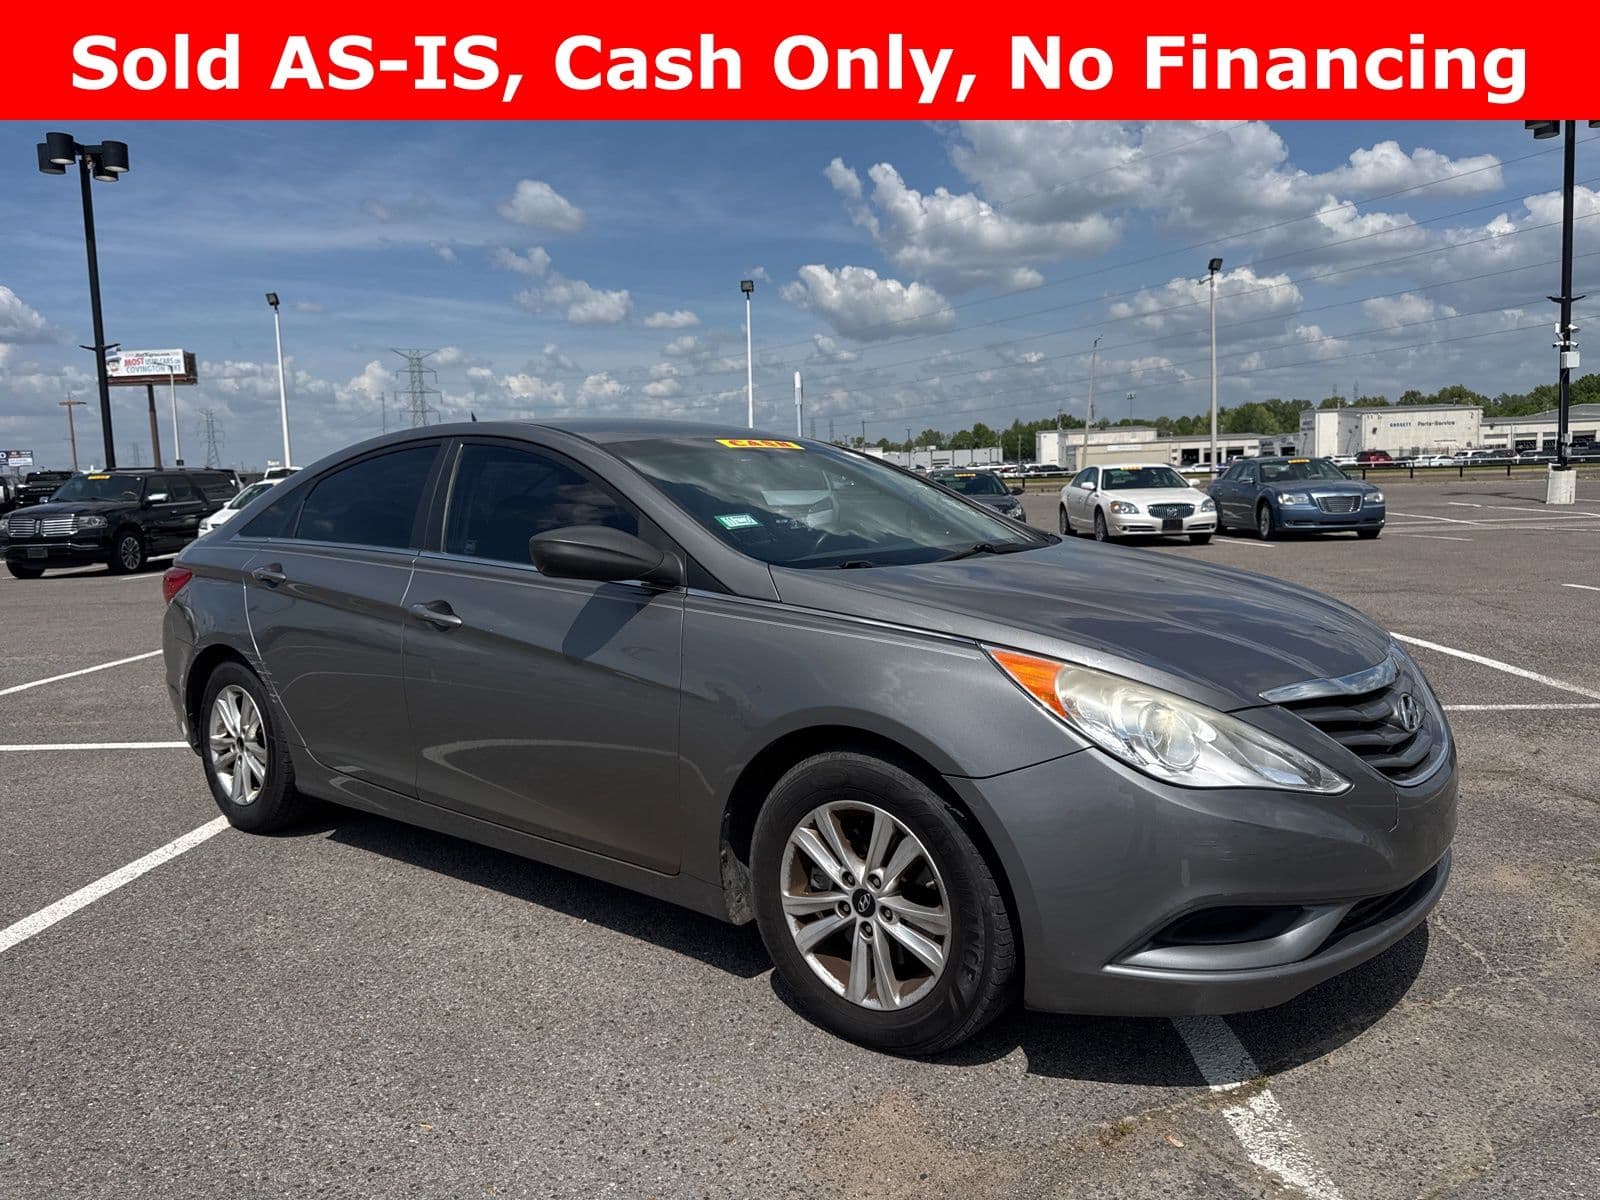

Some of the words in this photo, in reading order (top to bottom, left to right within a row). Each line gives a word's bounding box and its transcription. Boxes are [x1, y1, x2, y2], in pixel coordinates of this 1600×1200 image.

[124, 358, 144, 367] MOST
[126, 365, 166, 373] COVINGTON
[727, 440, 795, 448] CASH
